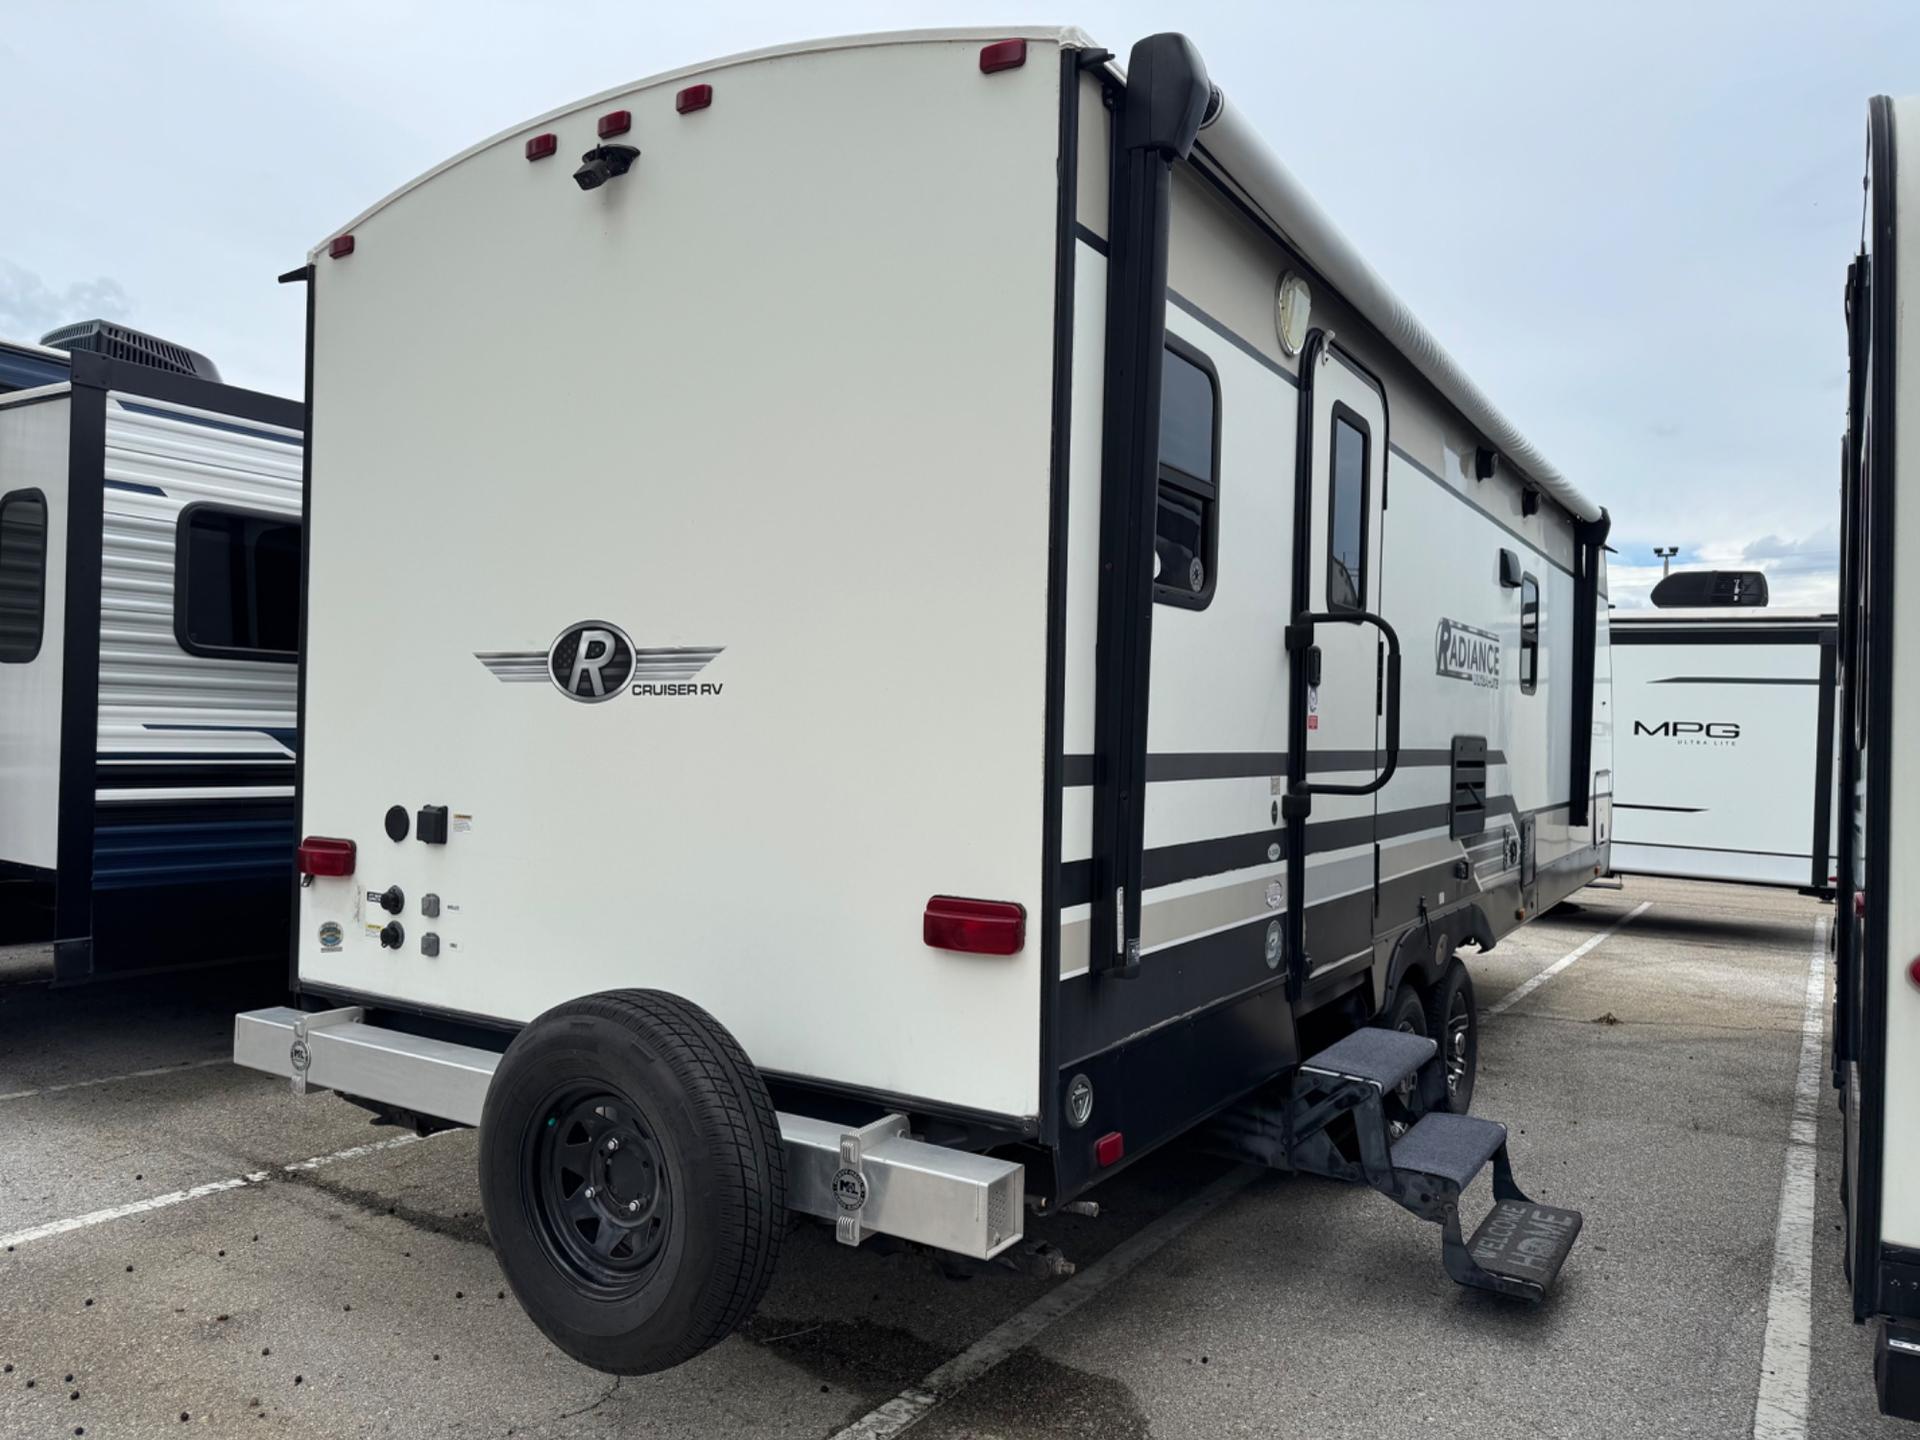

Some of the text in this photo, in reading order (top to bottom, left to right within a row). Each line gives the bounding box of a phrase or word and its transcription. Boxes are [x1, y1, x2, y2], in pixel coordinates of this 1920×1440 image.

[567, 630, 617, 697] R
[1437, 617, 1499, 676] RADIANCE
[631, 683, 723, 696] CRUISER RV
[1634, 720, 1740, 738] MPG
[1471, 1203, 1527, 1258] WELCOME
[1506, 1210, 1573, 1272] HOME
